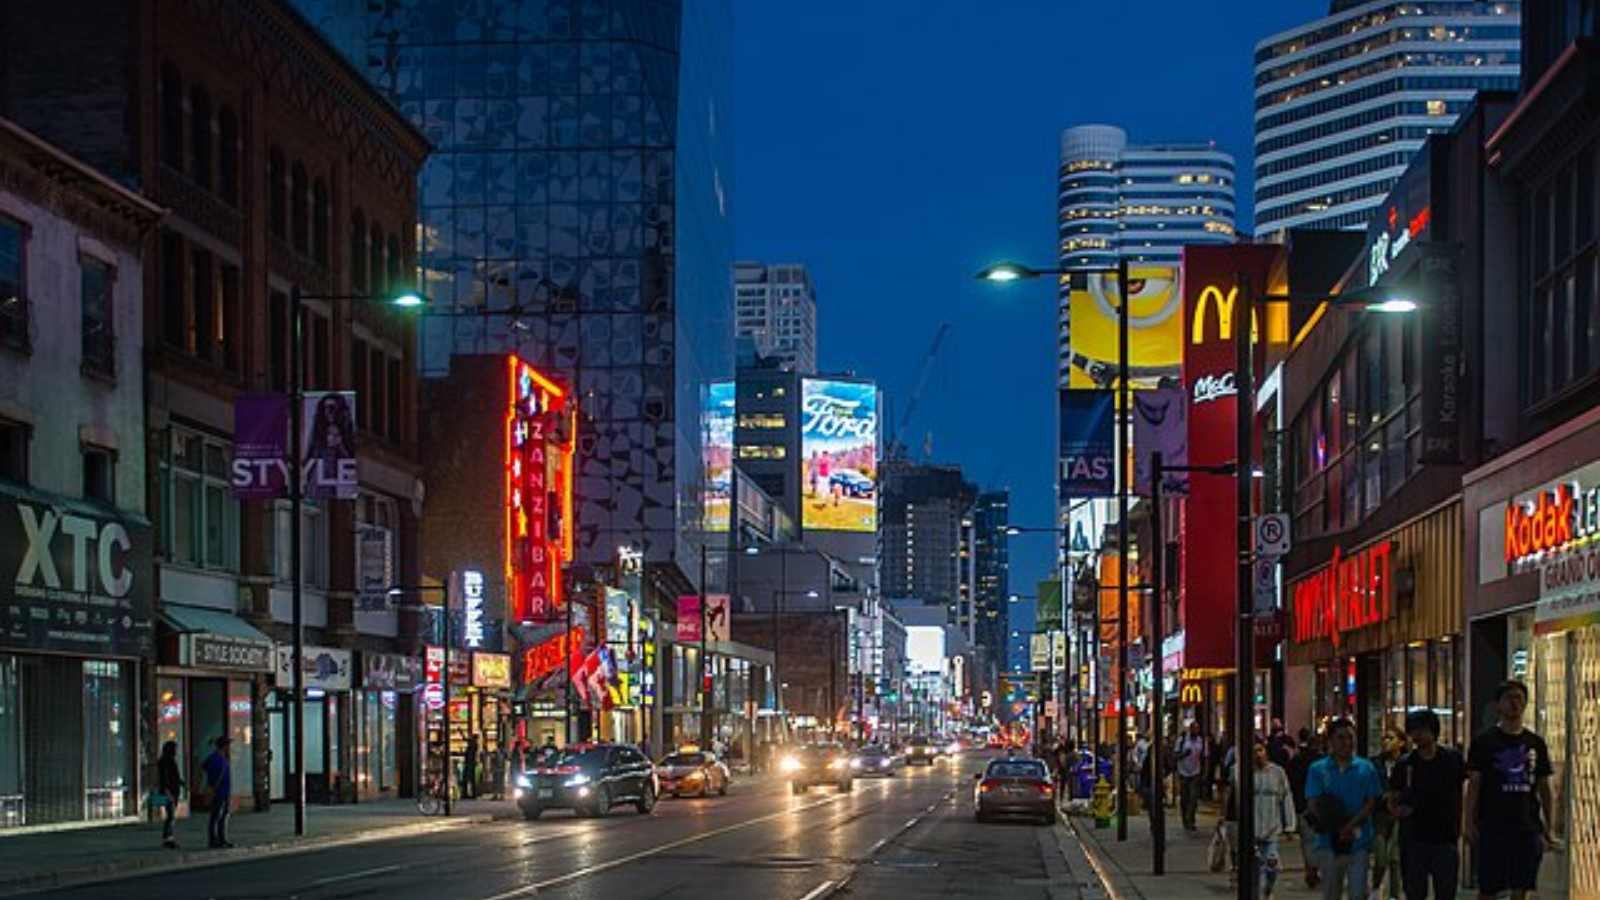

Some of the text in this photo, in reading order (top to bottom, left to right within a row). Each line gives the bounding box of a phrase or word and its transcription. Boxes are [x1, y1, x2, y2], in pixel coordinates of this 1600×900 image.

[802, 395, 876, 437] Ford
[1194, 372, 1239, 403] McC
[529, 421, 547, 615] ZANZIBAR
[1504, 485, 1574, 562] Kodak
[1573, 480, 1600, 538] LE
[15, 503, 134, 598] XTC
